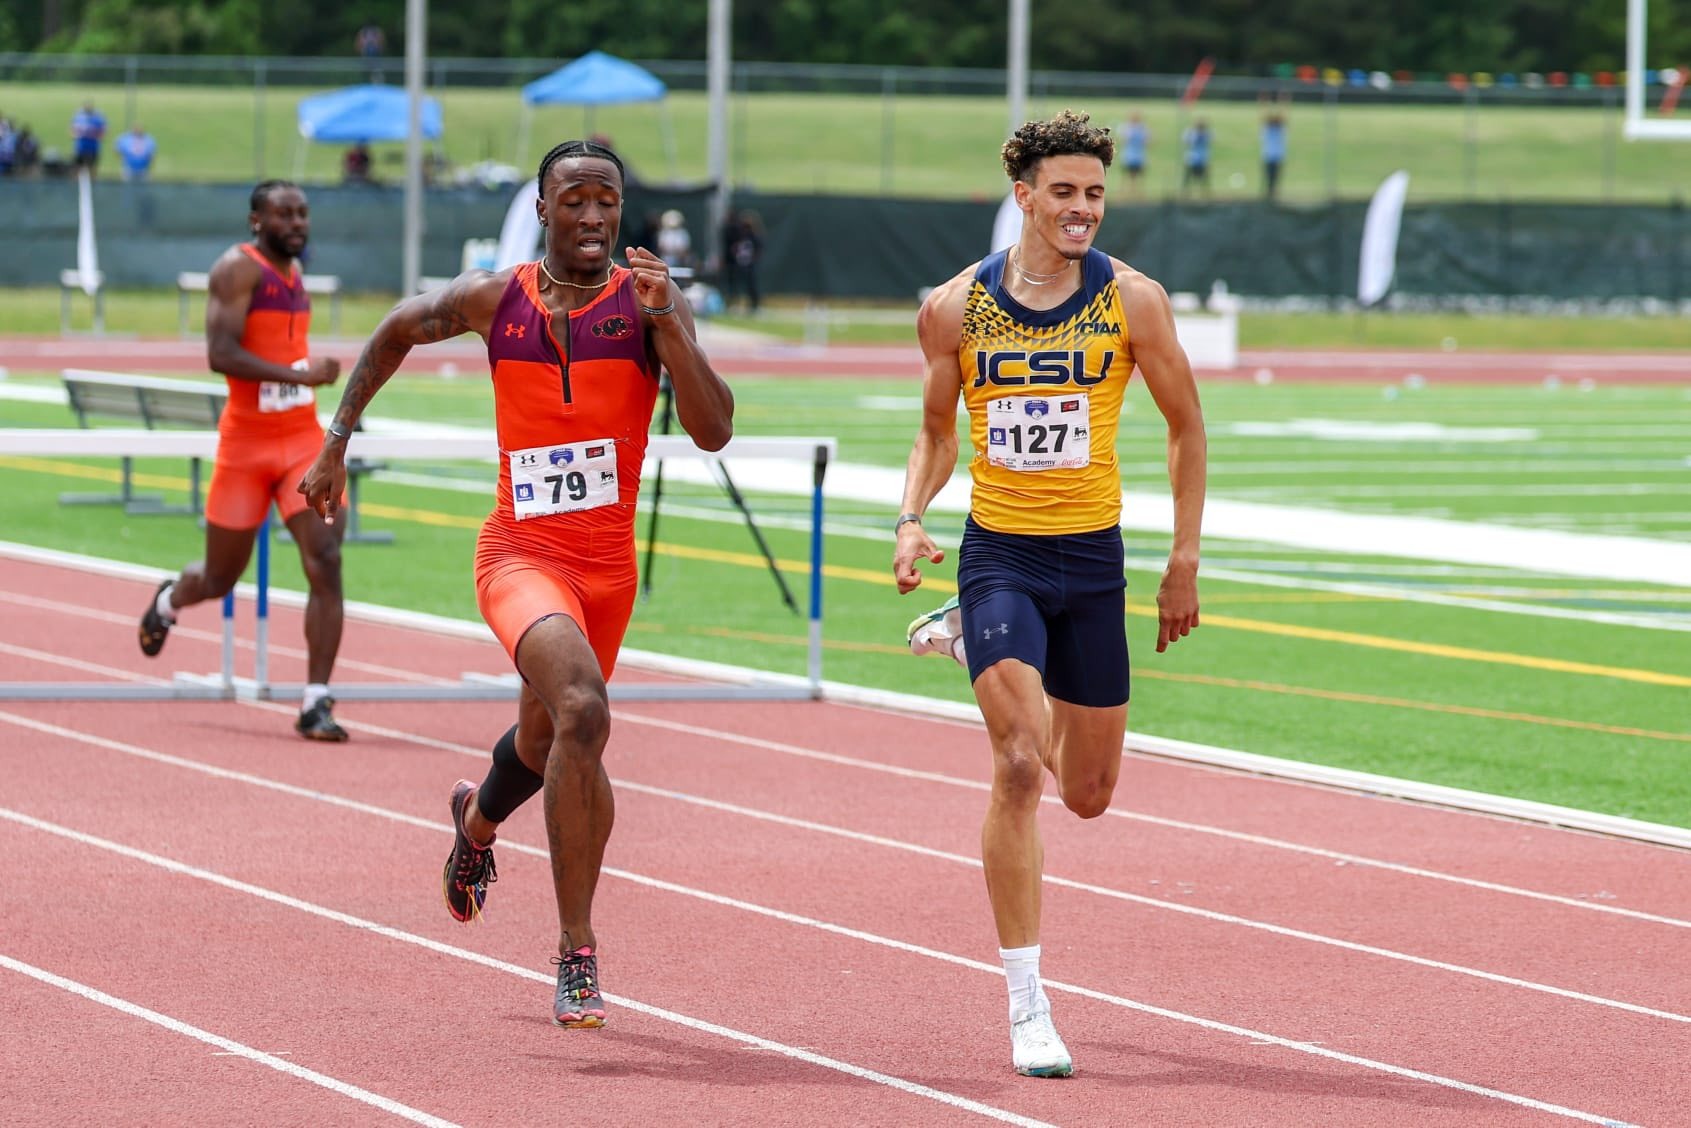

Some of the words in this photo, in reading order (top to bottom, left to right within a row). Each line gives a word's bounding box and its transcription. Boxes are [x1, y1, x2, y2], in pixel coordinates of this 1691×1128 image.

[1079, 322, 1121, 335] CIAA
[974, 350, 1114, 388] JCSU
[1009, 424, 1068, 454] 127
[1022, 459, 1056, 467] Academy
[544, 471, 587, 504] 79
